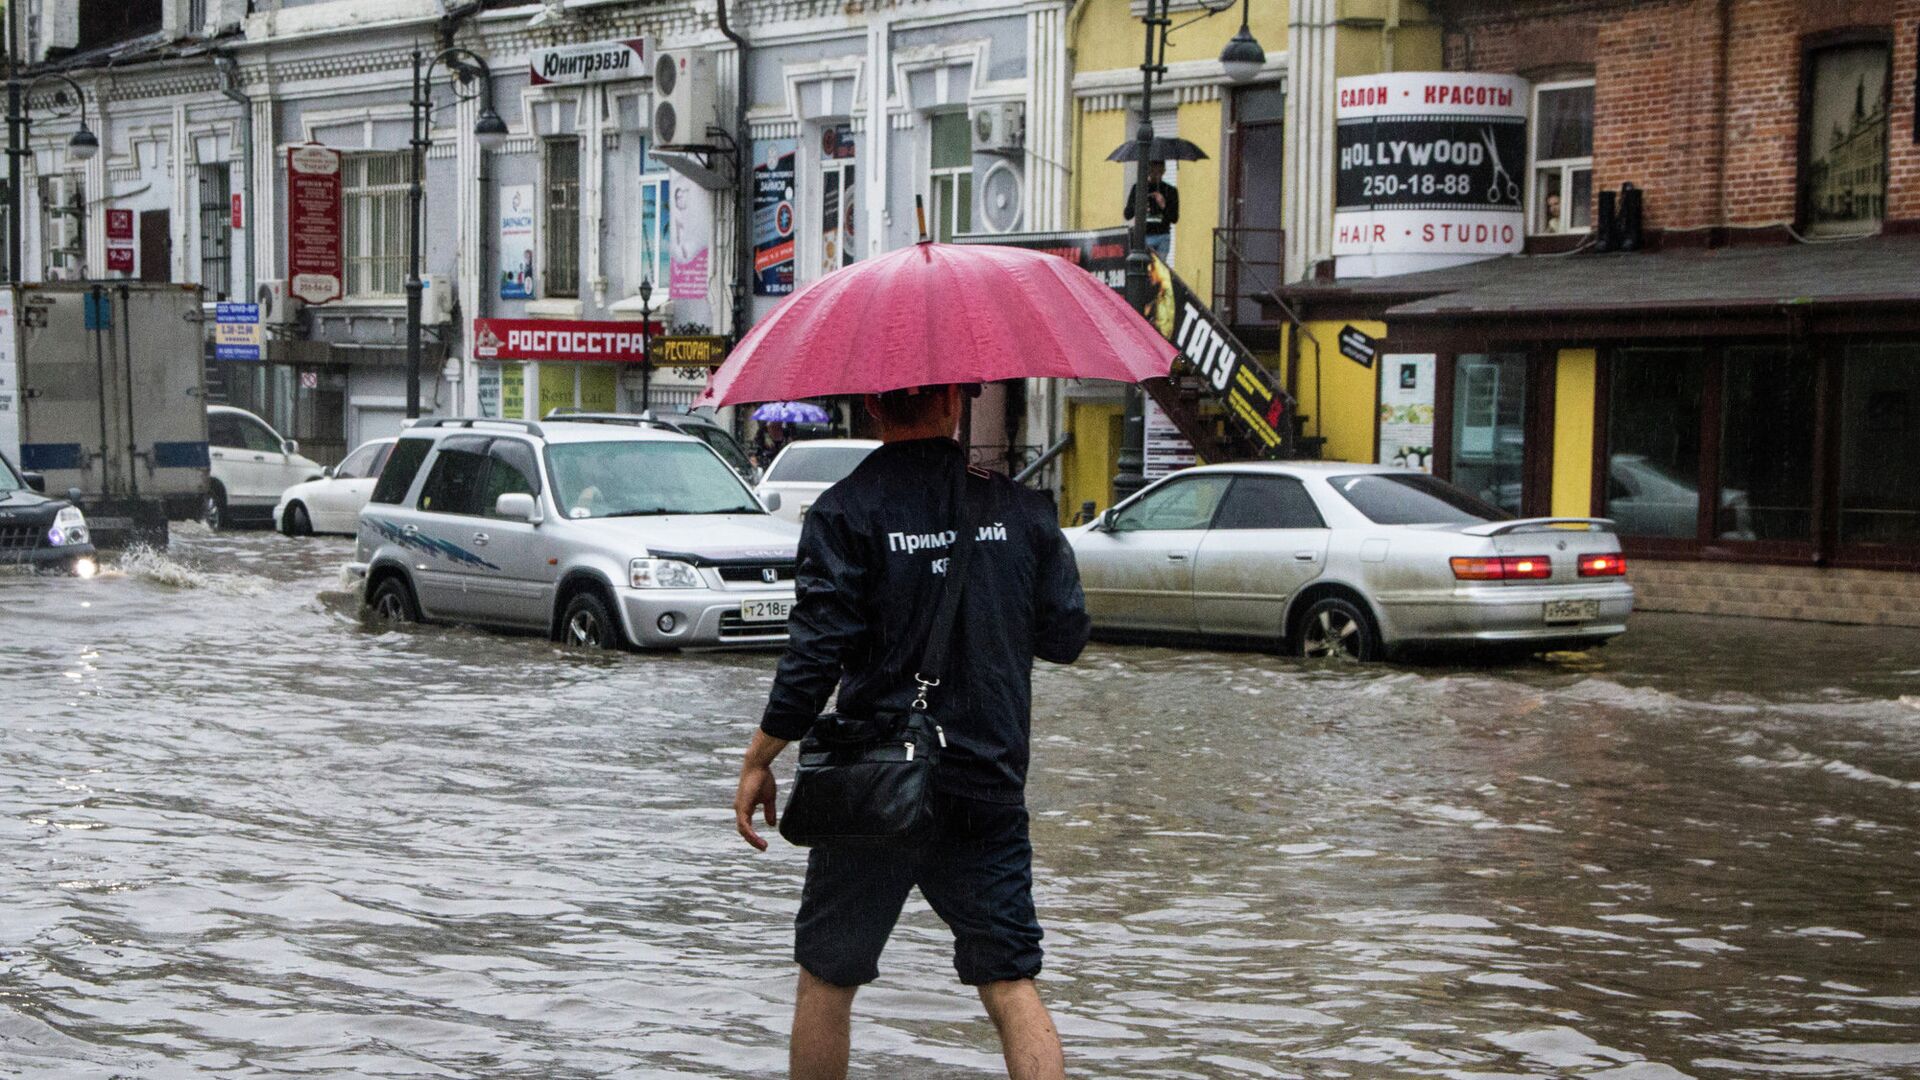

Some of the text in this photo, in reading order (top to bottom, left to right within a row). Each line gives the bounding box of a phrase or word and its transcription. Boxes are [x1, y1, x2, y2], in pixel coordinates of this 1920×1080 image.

[543, 50, 630, 79] Юнитрэвэл
[1340, 85, 1513, 108] САЛОН КРАСОТЫ
[1341, 139, 1484, 170] HOLLYWOOD
[1363, 174, 1471, 197] 250-18-88
[1339, 223, 1515, 244] HAIR STUDIO
[508, 330, 651, 354] РОСГОССТРА
[664, 341, 710, 361] РЕСТОРАН
[1176, 301, 1237, 390] ТАТУ
[749, 602, 795, 617] Т218Е
